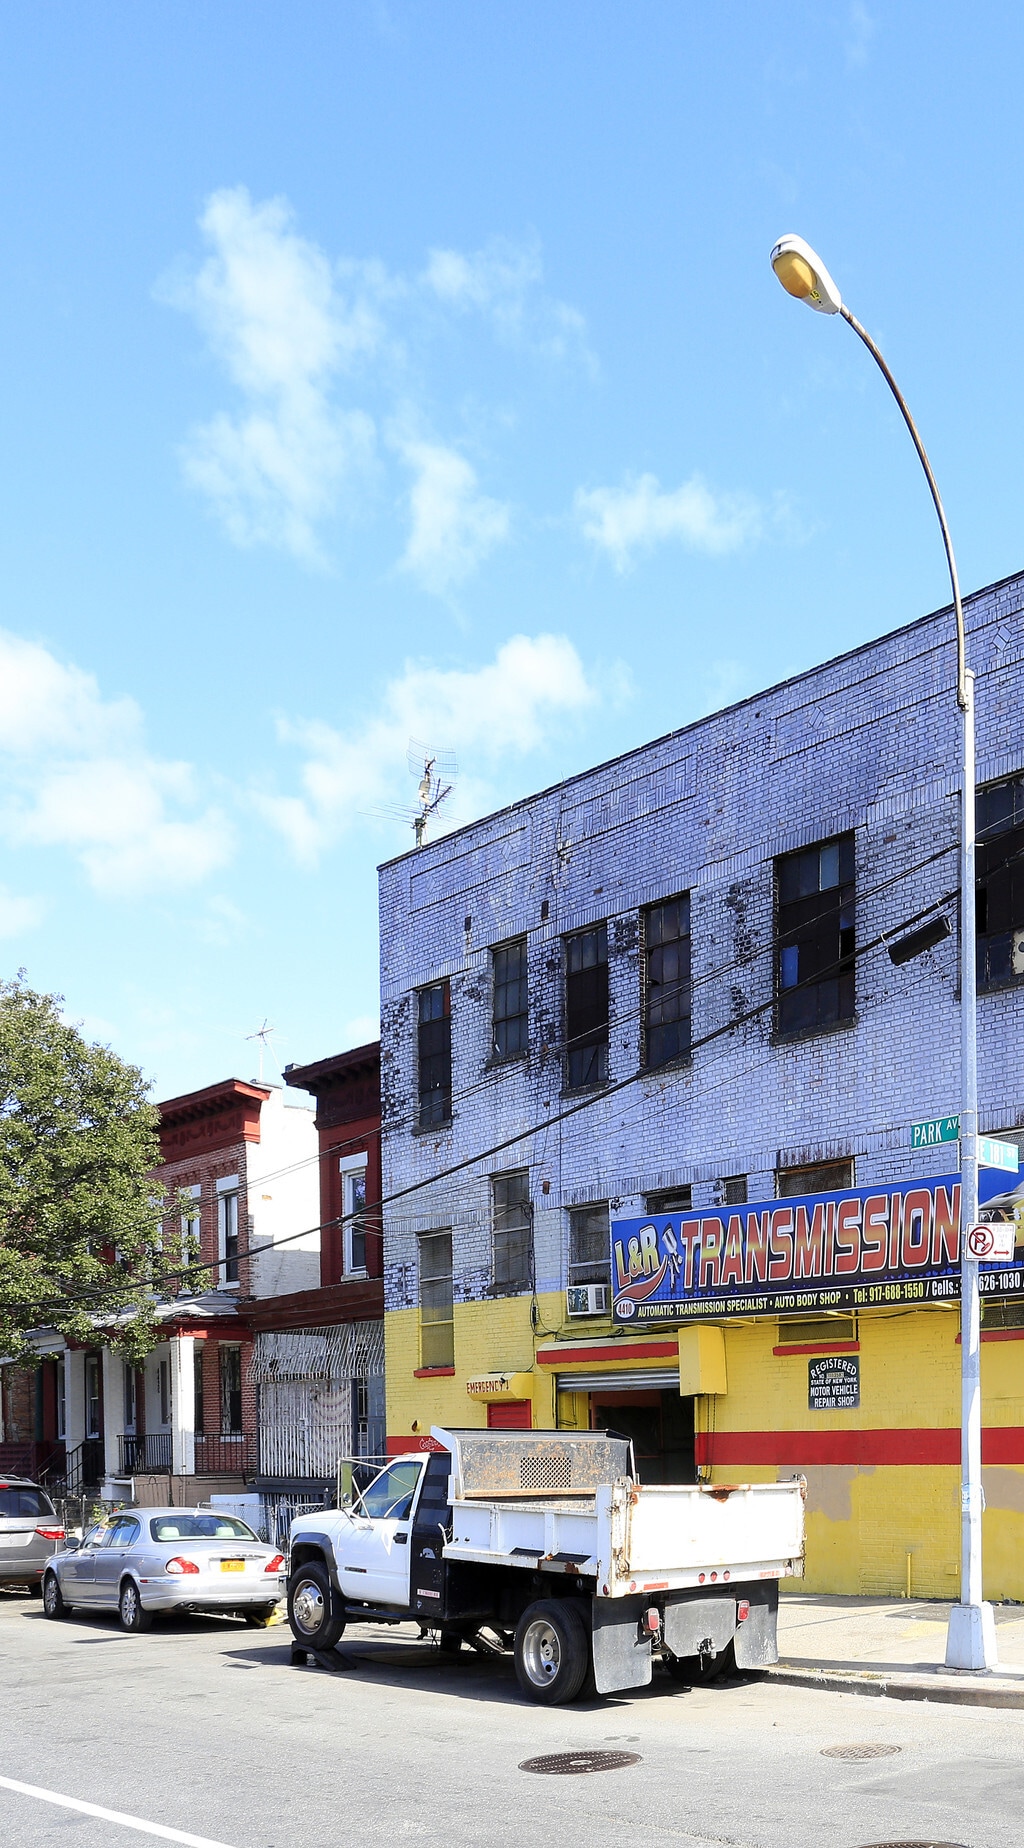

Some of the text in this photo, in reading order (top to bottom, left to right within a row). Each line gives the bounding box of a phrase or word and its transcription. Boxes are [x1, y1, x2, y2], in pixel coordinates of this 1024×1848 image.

[914, 1118, 958, 1146] PARK AV
[980, 1140, 1015, 1165] E 181 ST
[614, 1184, 961, 1290] L&R TRANSMISSION
[617, 1303, 633, 1316] 4410
[637, 1306, 674, 1318] AUTOMATIC
[675, 1301, 727, 1316] TRANSMISSION
[727, 1297, 768, 1312] SPECIALIST
[774, 1295, 796, 1309] AUTO
[796, 1293, 818, 1307] BODY
[819, 1291, 841, 1305] SHOP
[853, 1288, 868, 1304] Tel:
[869, 1282, 924, 1302] 917-688-1550
[810, 1358, 857, 1379] REGISTERED
[466, 1380, 503, 1394] EMERGENCY
[810, 1384, 859, 1397] MOTOR VEHICLE
[814, 1395, 855, 1408] REPAIR SHOP
